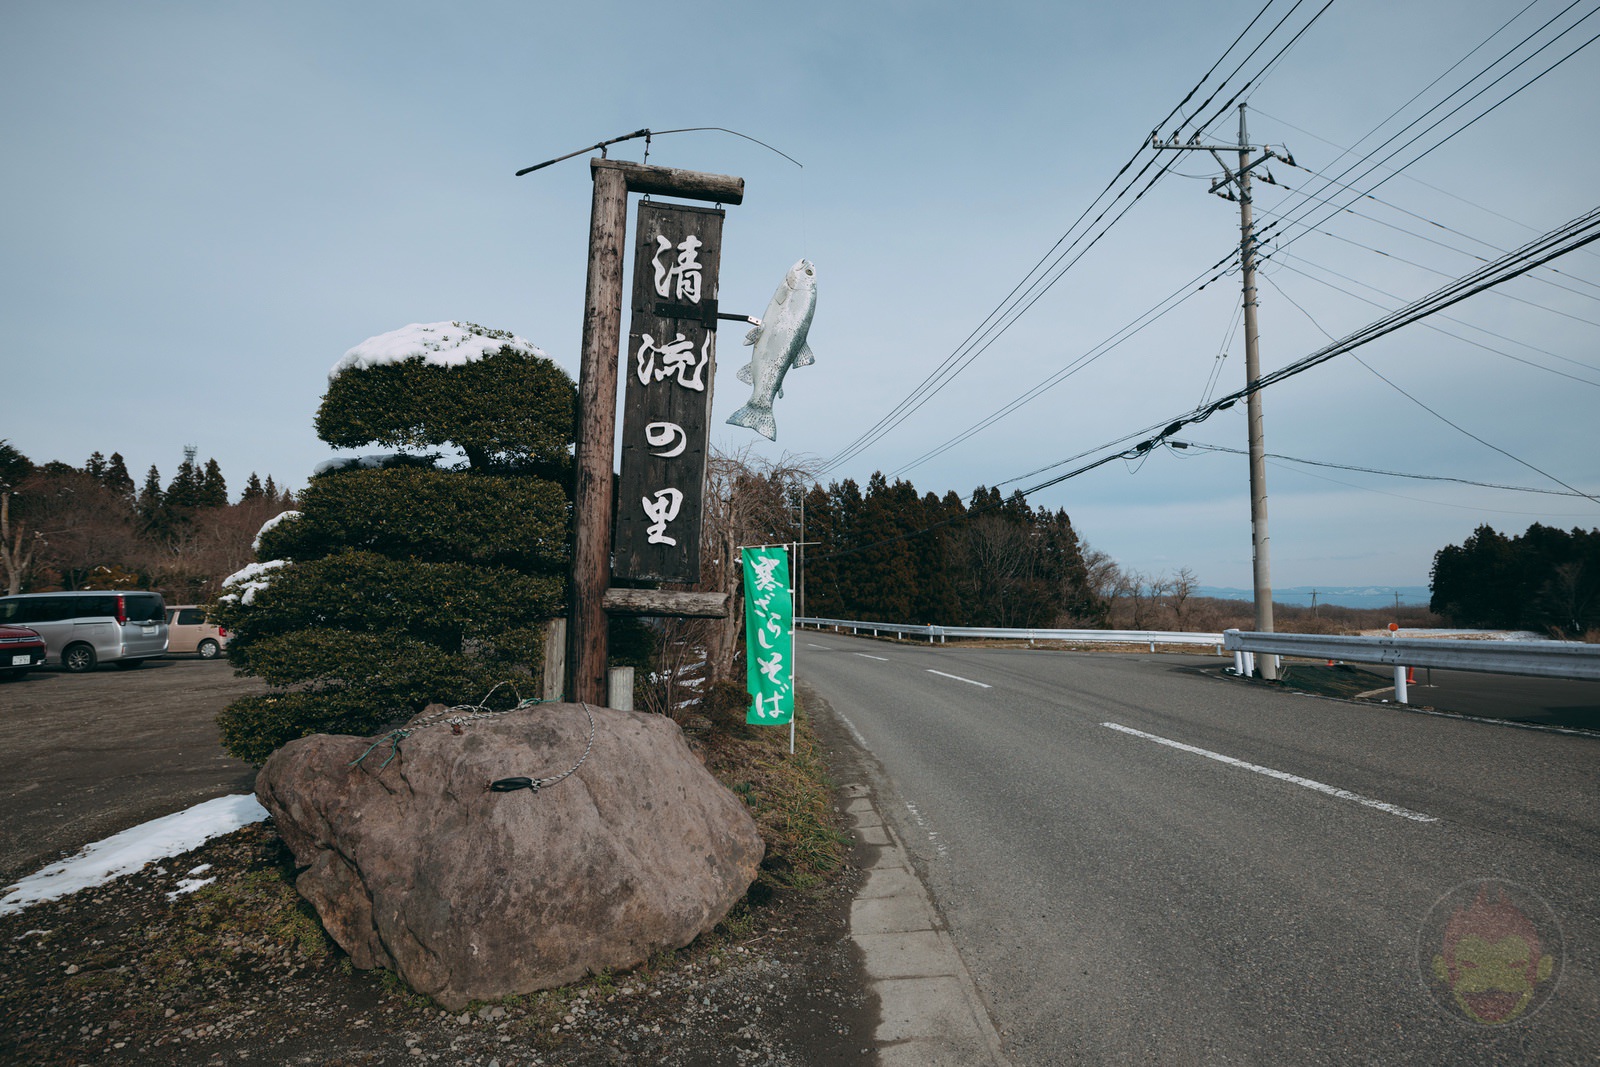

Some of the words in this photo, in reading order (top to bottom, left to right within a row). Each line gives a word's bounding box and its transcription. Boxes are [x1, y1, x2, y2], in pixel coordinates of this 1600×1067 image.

[637, 234, 711, 547] 清流の里
[751, 556, 790, 719] 寒ざらしそば
